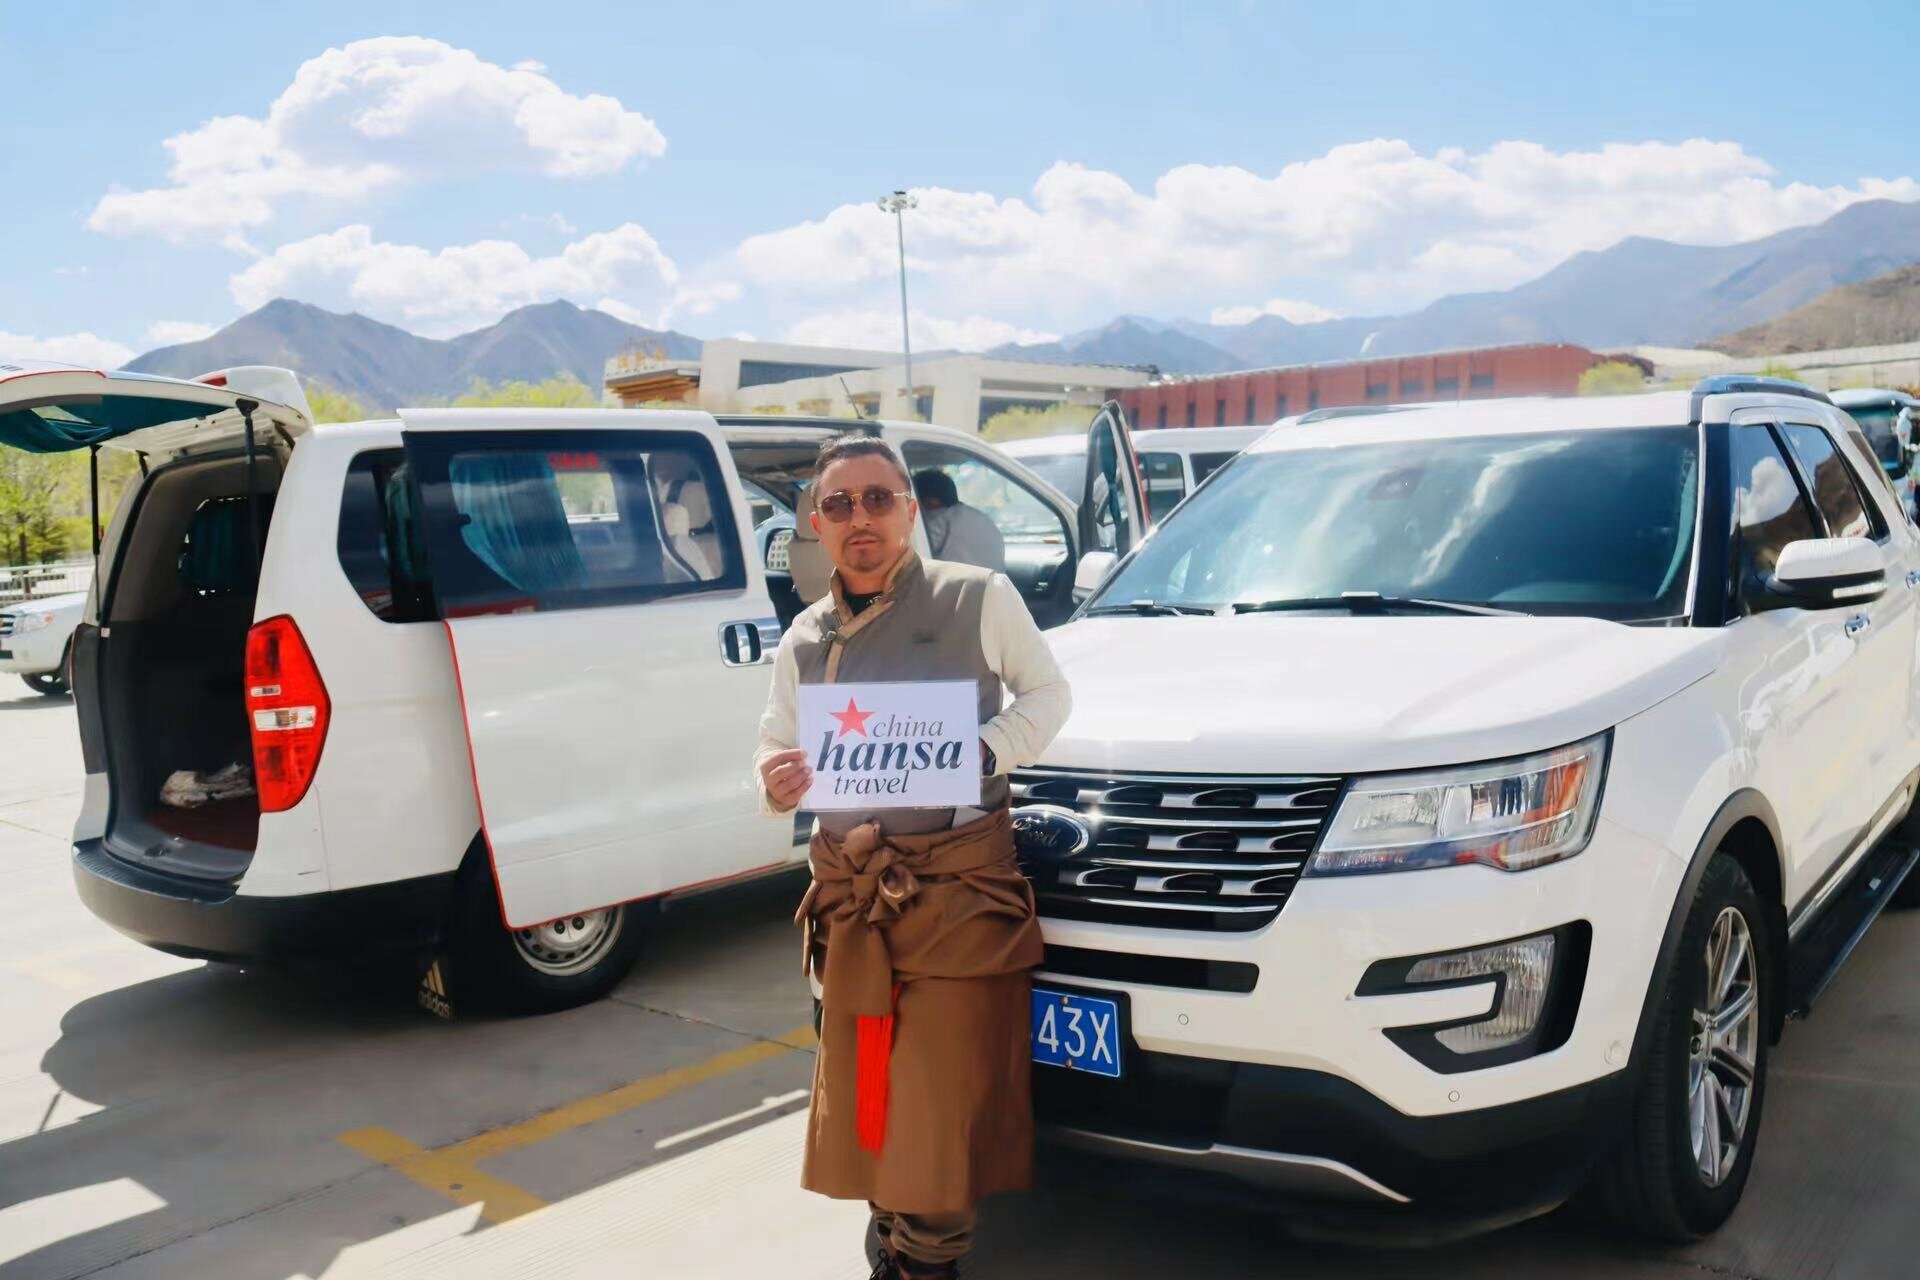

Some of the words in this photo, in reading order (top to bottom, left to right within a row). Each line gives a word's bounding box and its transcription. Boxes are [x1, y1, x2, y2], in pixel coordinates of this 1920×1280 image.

[872, 714, 943, 738] china
[816, 730, 962, 772] hansa
[834, 770, 910, 795] travel
[1032, 1003, 1113, 1064] 43X
